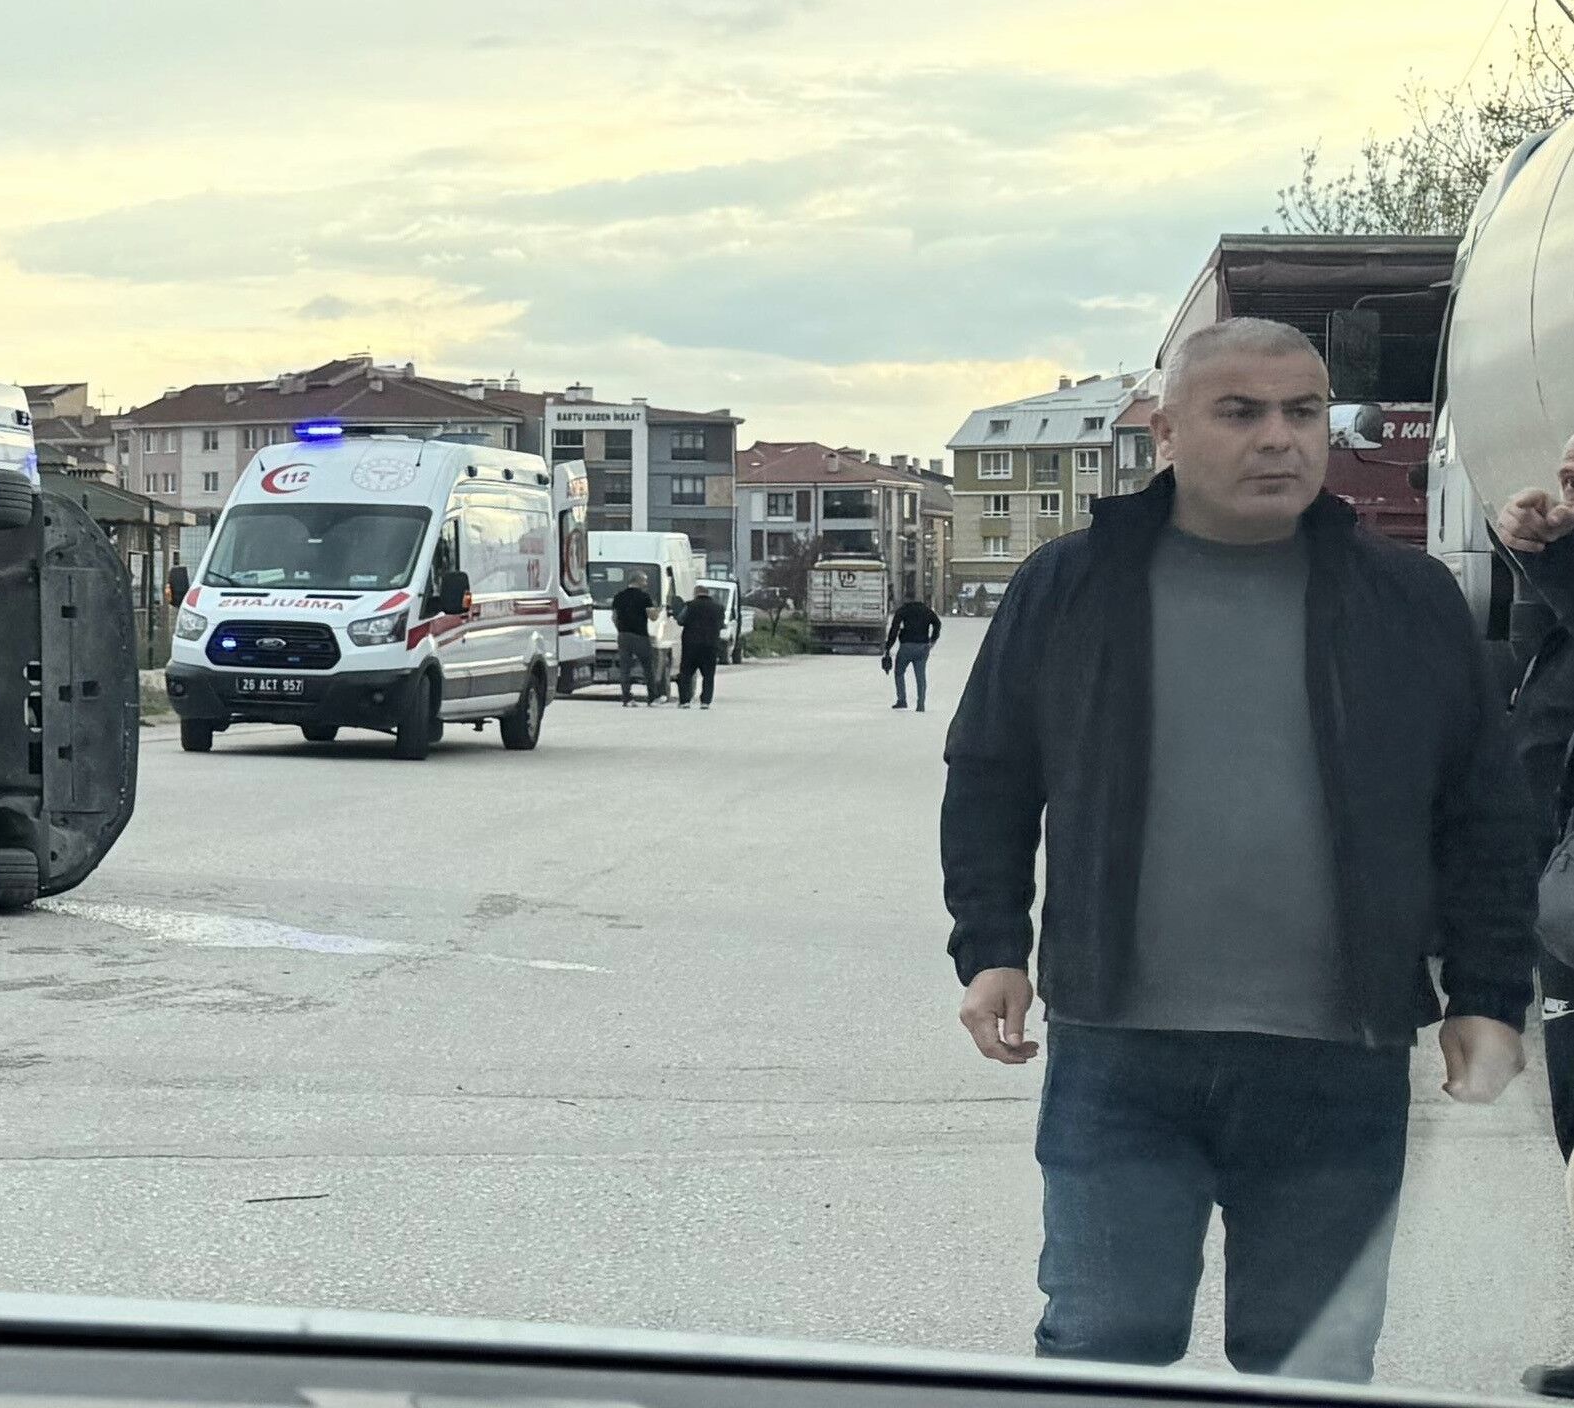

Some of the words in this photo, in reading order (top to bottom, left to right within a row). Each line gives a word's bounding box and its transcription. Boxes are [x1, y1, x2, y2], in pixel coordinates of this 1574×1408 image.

[280, 471, 310, 484] 112
[259, 678, 277, 691] ACT
[282, 678, 302, 691] 957
